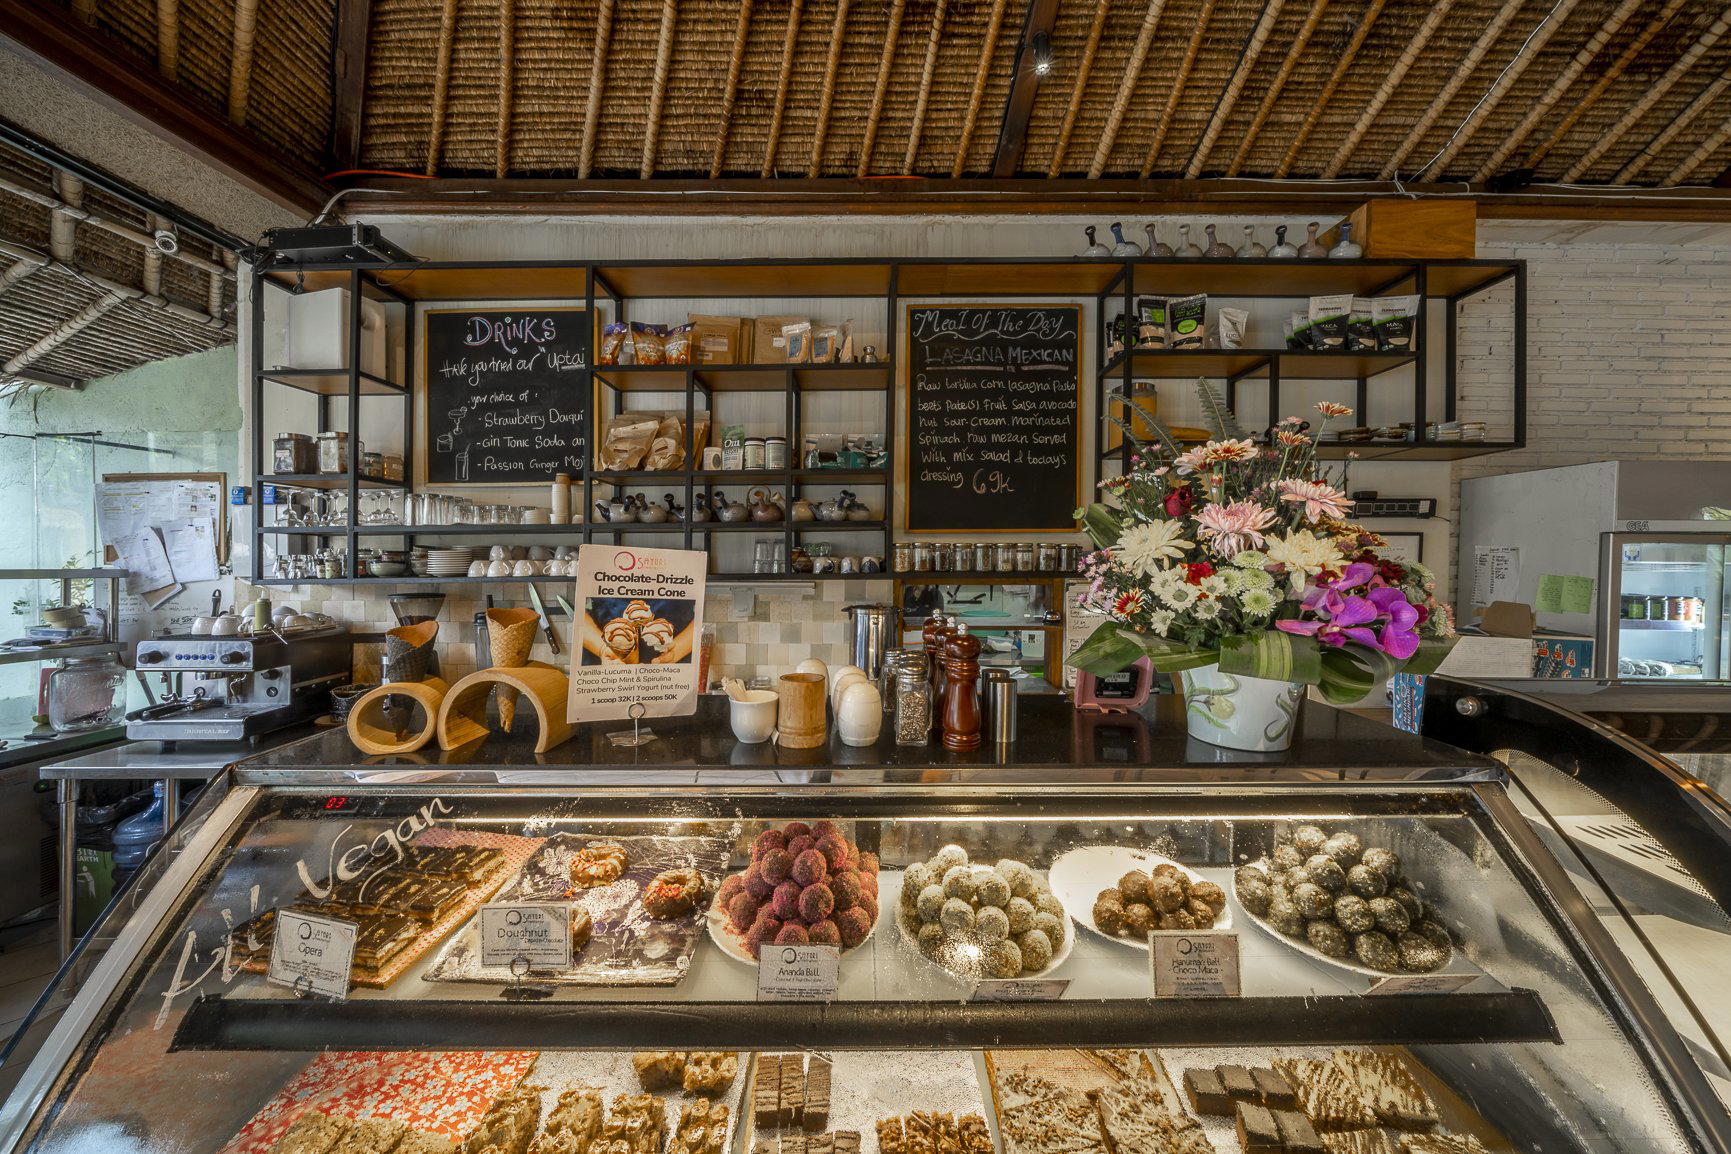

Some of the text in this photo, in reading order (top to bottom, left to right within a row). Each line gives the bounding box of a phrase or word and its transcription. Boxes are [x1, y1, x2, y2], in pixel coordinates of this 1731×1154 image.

[998, 311, 1022, 331] The
[1027, 311, 1064, 339] Day
[925, 346, 1073, 364] LASAGNA MEXICAN
[484, 409, 545, 430] Strawberry
[535, 434, 565, 449] Soda
[485, 456, 524, 471] Passion
[530, 459, 559, 473] Ginger
[594, 571, 694, 585] Chocolate-Drizzle
[598, 585, 686, 597] Ice Cream Cone
[643, 675, 671, 683] Spirulina
[636, 684, 659, 692] Yogurt
[296, 797, 454, 903] Vegan
[497, 928, 548, 939] Doughnut
[298, 942, 322, 956] Opera
[779, 968, 804, 976] Ananda
